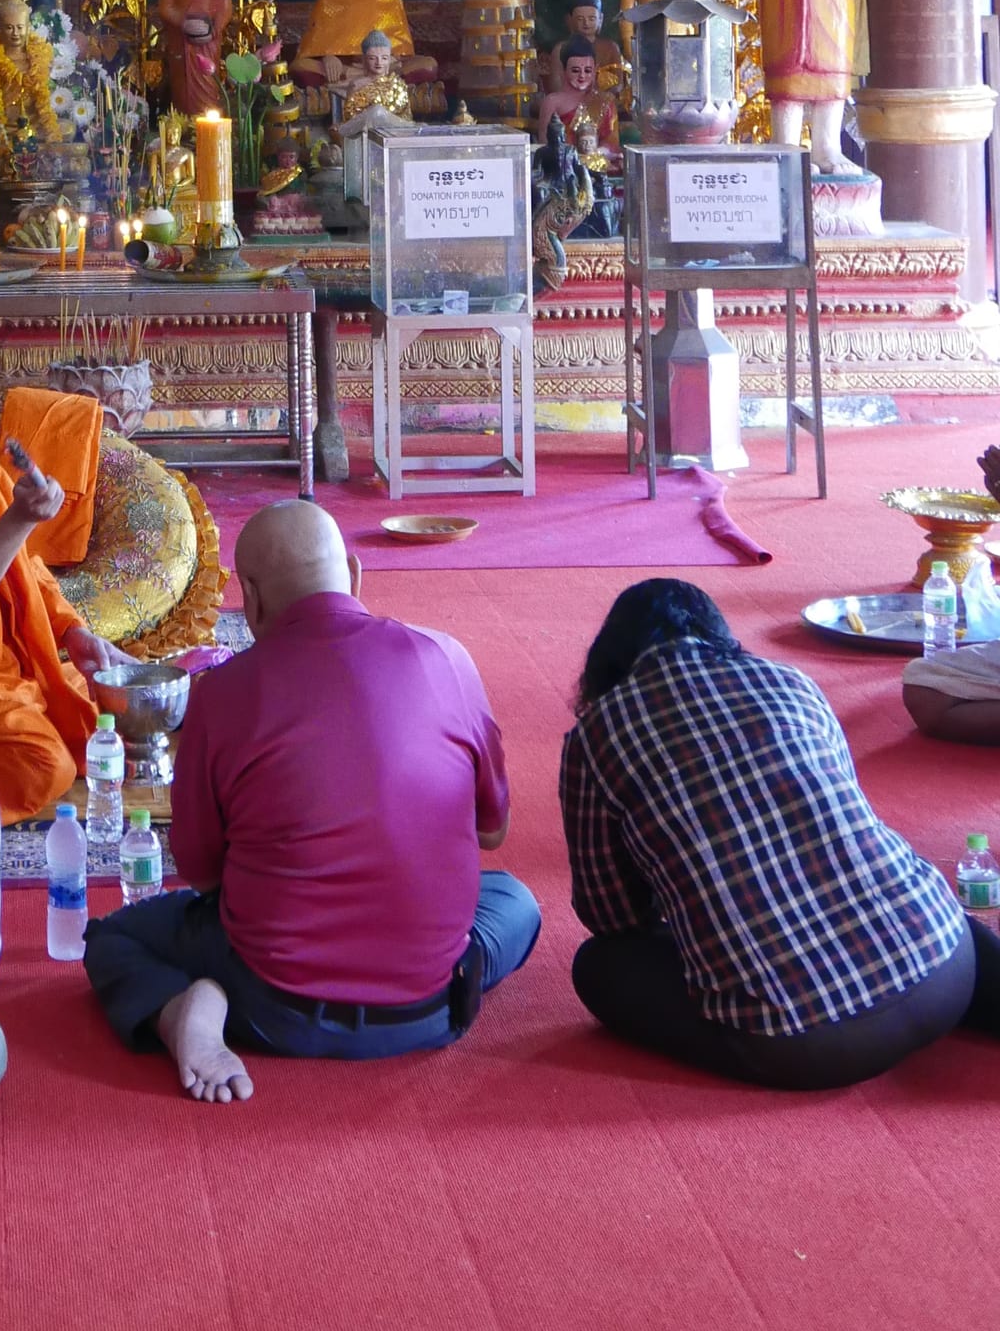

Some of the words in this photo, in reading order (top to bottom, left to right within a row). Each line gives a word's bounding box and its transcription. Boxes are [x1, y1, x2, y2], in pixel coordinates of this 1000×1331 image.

[411, 192, 452, 201] DONATION
[453, 191, 470, 200] FOR
[471, 190, 505, 199] BUDDHA
[674, 195, 715, 204] DONATION
[717, 195, 734, 204] FOR
[735, 194, 768, 203] BUDDHA
[424, 205, 489, 228] พุทธบูชา
[686, 210, 753, 231] พุทธบูชา
